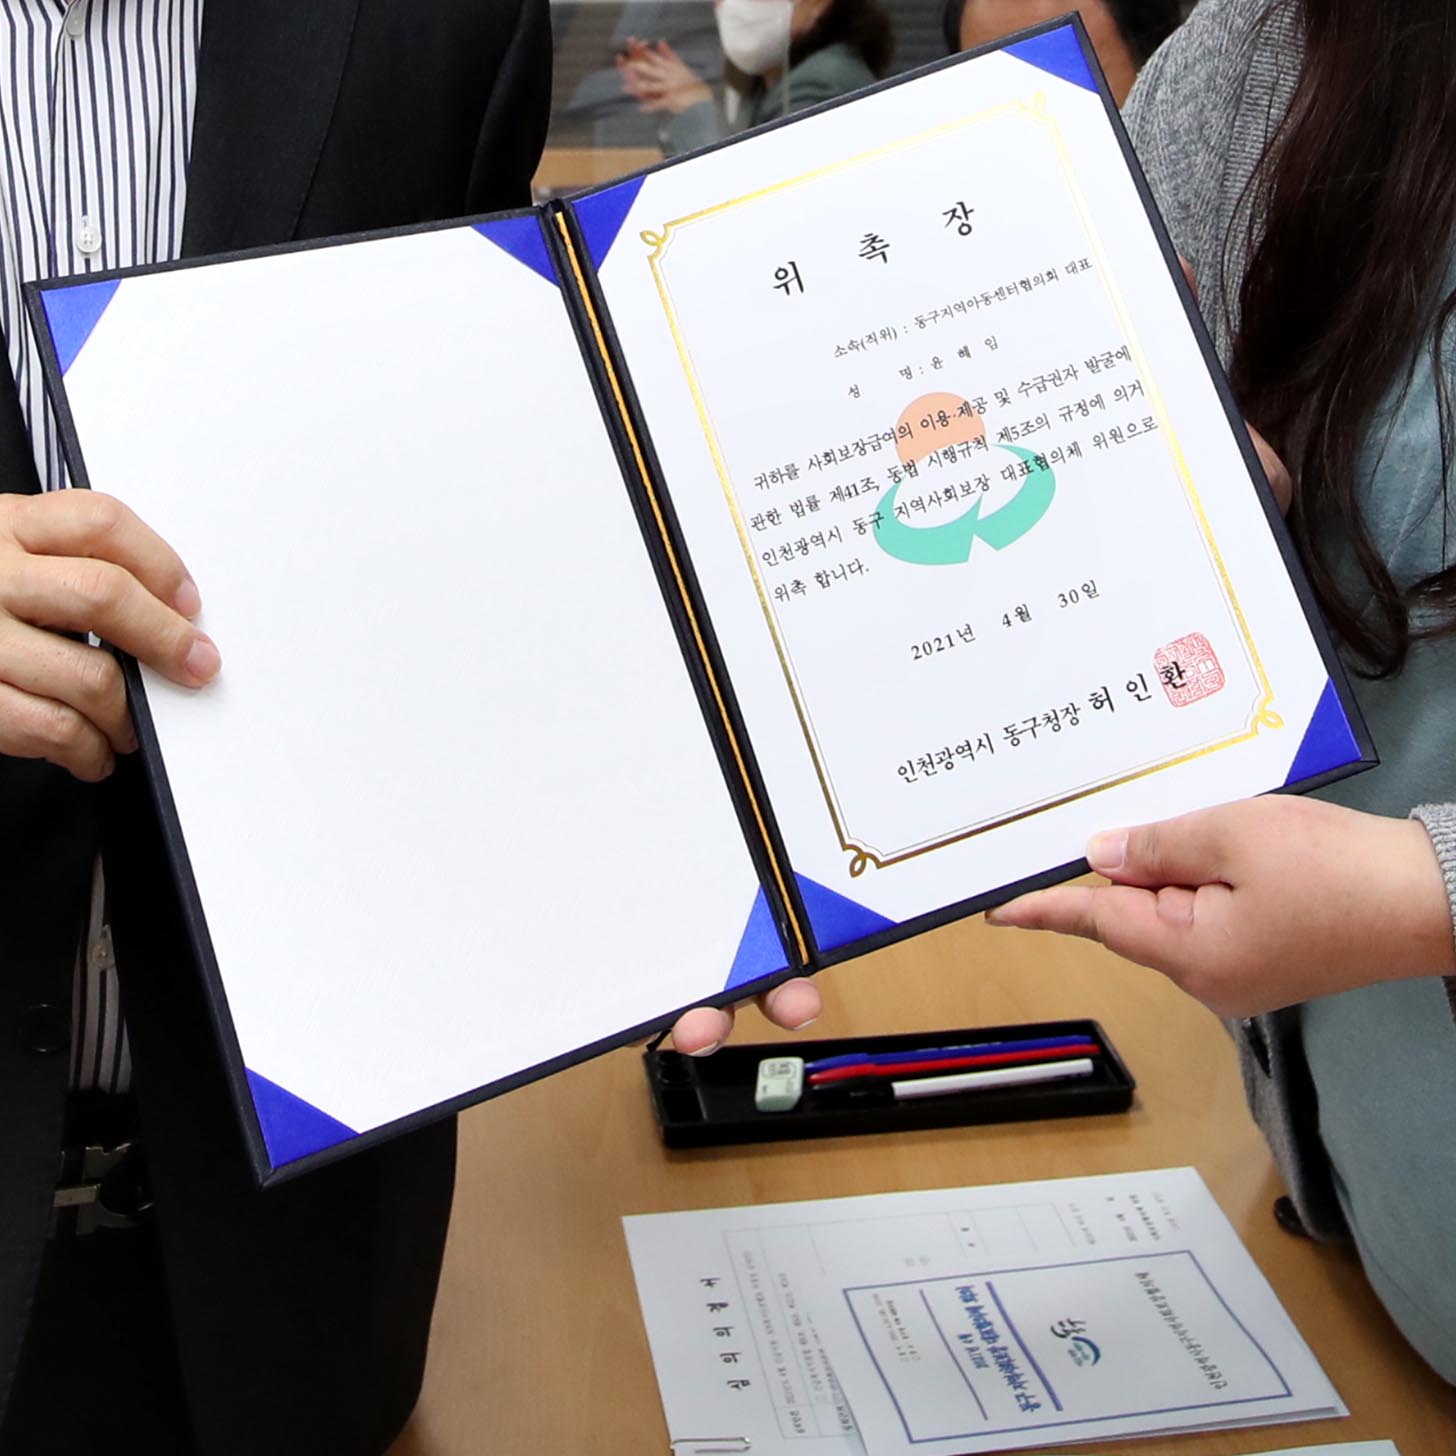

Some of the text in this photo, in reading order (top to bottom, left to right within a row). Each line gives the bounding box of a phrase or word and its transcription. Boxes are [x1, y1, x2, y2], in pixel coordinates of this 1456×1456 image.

[772, 200, 975, 297] 위 촉 장
[834, 326, 898, 358] 소속(직위)
[914, 267, 1059, 330] 동구지역아동센터협의회
[1064, 257, 1093, 275] 대표
[753, 462, 800, 490] 귀하를
[808, 421, 914, 472] 사회보장급여의
[993, 387, 1012, 408] 및
[1017, 363, 1079, 398] 수급권자
[1083, 344, 1132, 375] 발굴에
[848, 384, 861, 399] 성
[930, 355, 943, 370] 윤
[984, 335, 999, 351] 임
[750, 379, 1145, 532] 관한 법률 제41조, 동법 시행규칙 제5조의 규정에 의거
[761, 415, 1159, 567] 인천광역시 동구 지역사회보장 대표협의체 위원으로
[774, 557, 870, 603] 위촉 합니다.
[910, 579, 1100, 661] 2021년 4월 30일
[897, 732, 995, 784] 인천광역시
[1002, 701, 1081, 748] 동구청장
[1087, 685, 1115, 713] 허
[1125, 672, 1153, 703] 인
